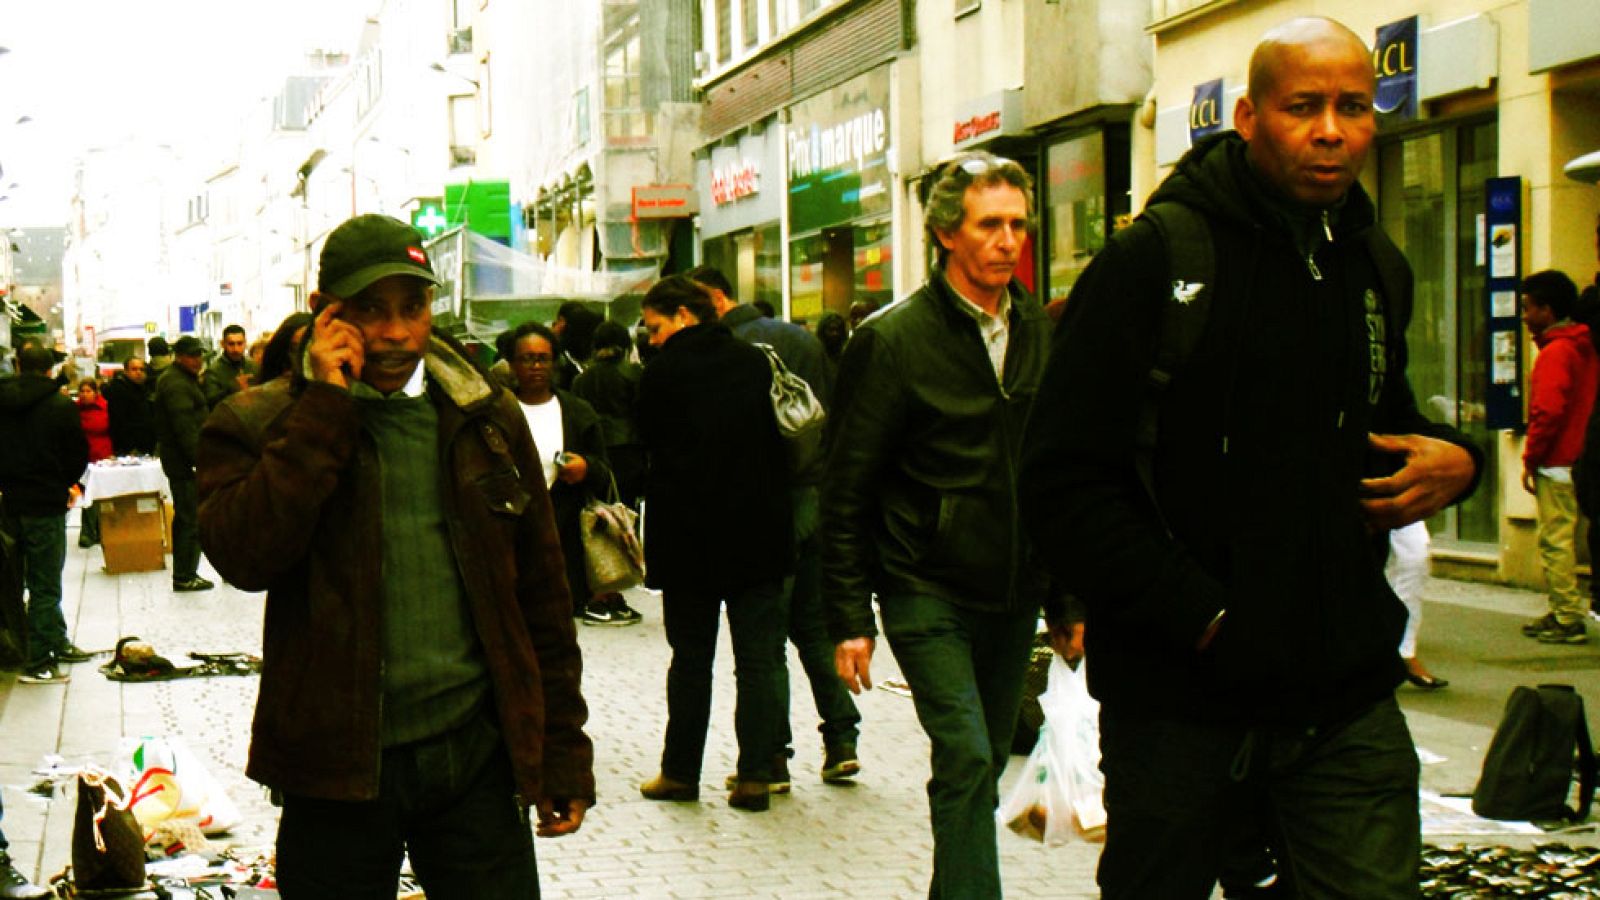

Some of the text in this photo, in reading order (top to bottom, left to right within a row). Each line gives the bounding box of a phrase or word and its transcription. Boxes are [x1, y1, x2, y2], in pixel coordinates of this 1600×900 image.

[1373, 41, 1414, 78] LCL
[1190, 99, 1221, 129] LCL
[822, 108, 885, 171] marque
